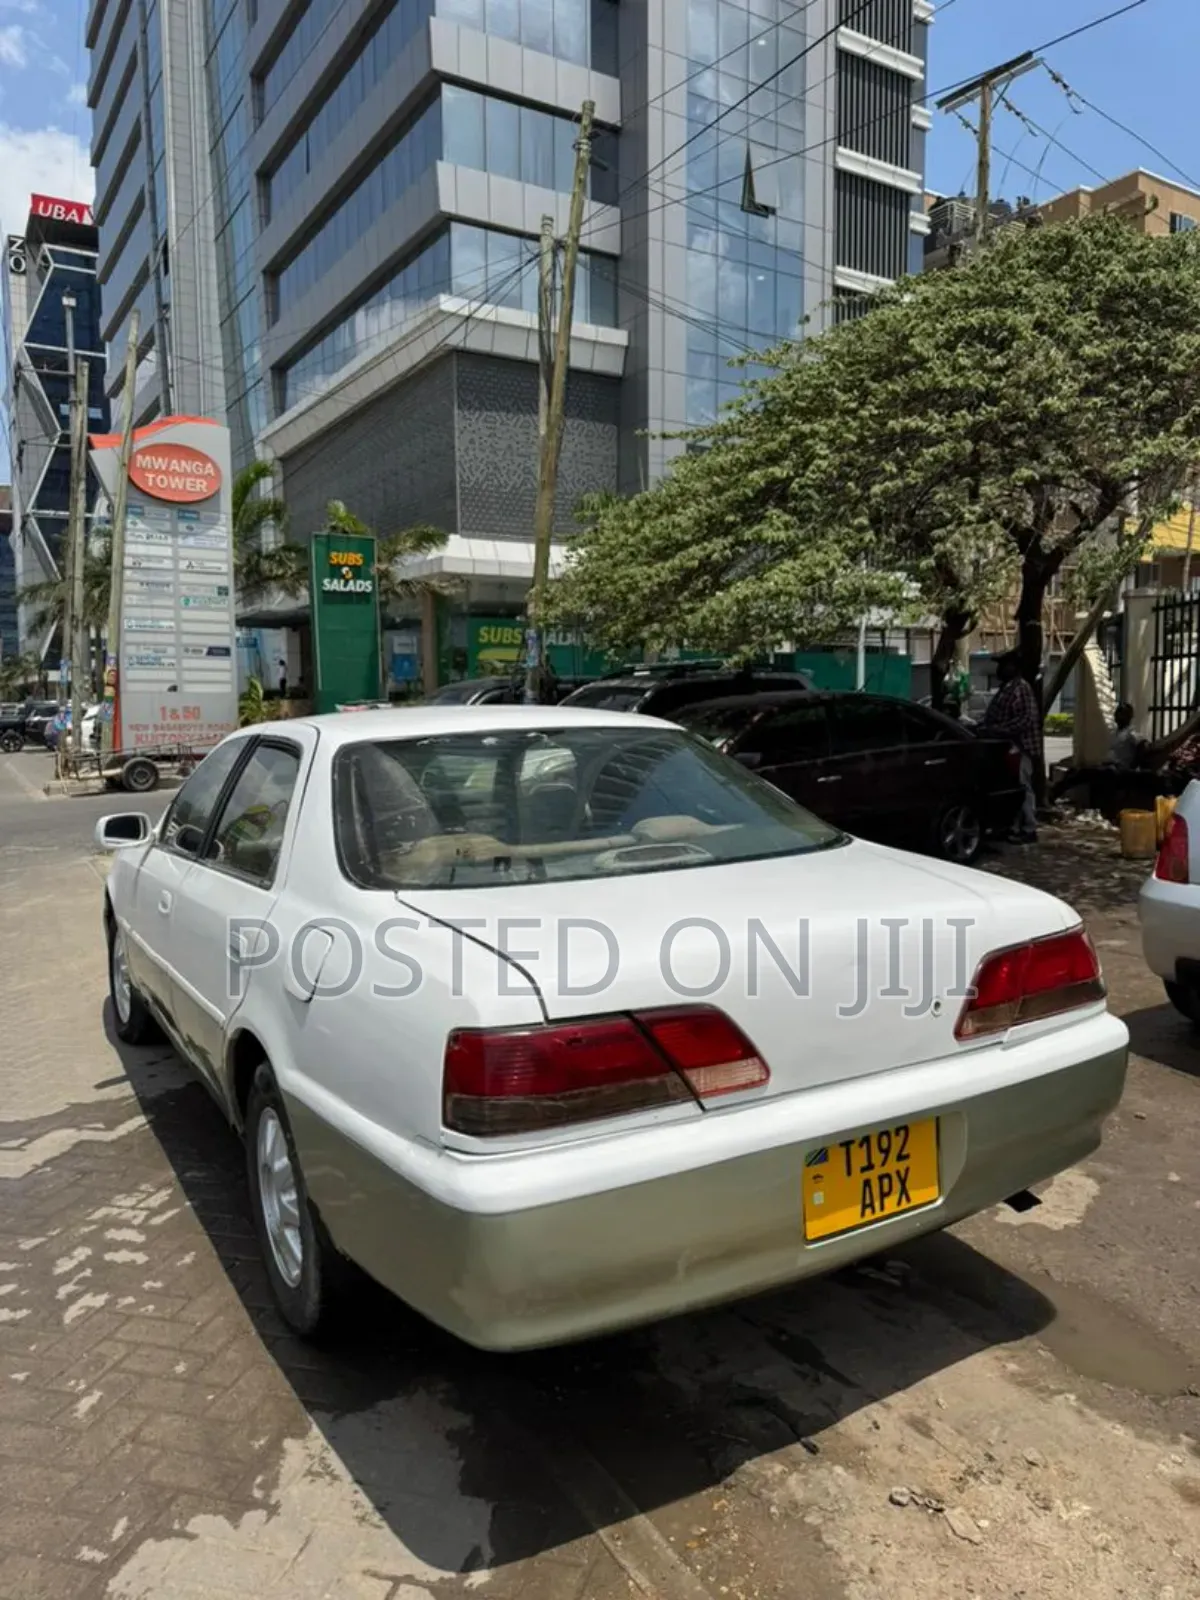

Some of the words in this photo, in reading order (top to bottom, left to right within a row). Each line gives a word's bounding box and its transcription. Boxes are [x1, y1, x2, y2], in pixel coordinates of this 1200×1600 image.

[39, 201, 79, 223] UBA
[136, 454, 216, 477] MWANGA
[144, 472, 209, 493] TOWER
[329, 550, 364, 566] SUBS
[321, 577, 373, 593] SALADS
[478, 625, 523, 645] SUBS
[838, 1124, 911, 1177] T192
[860, 1166, 912, 1219] APX
